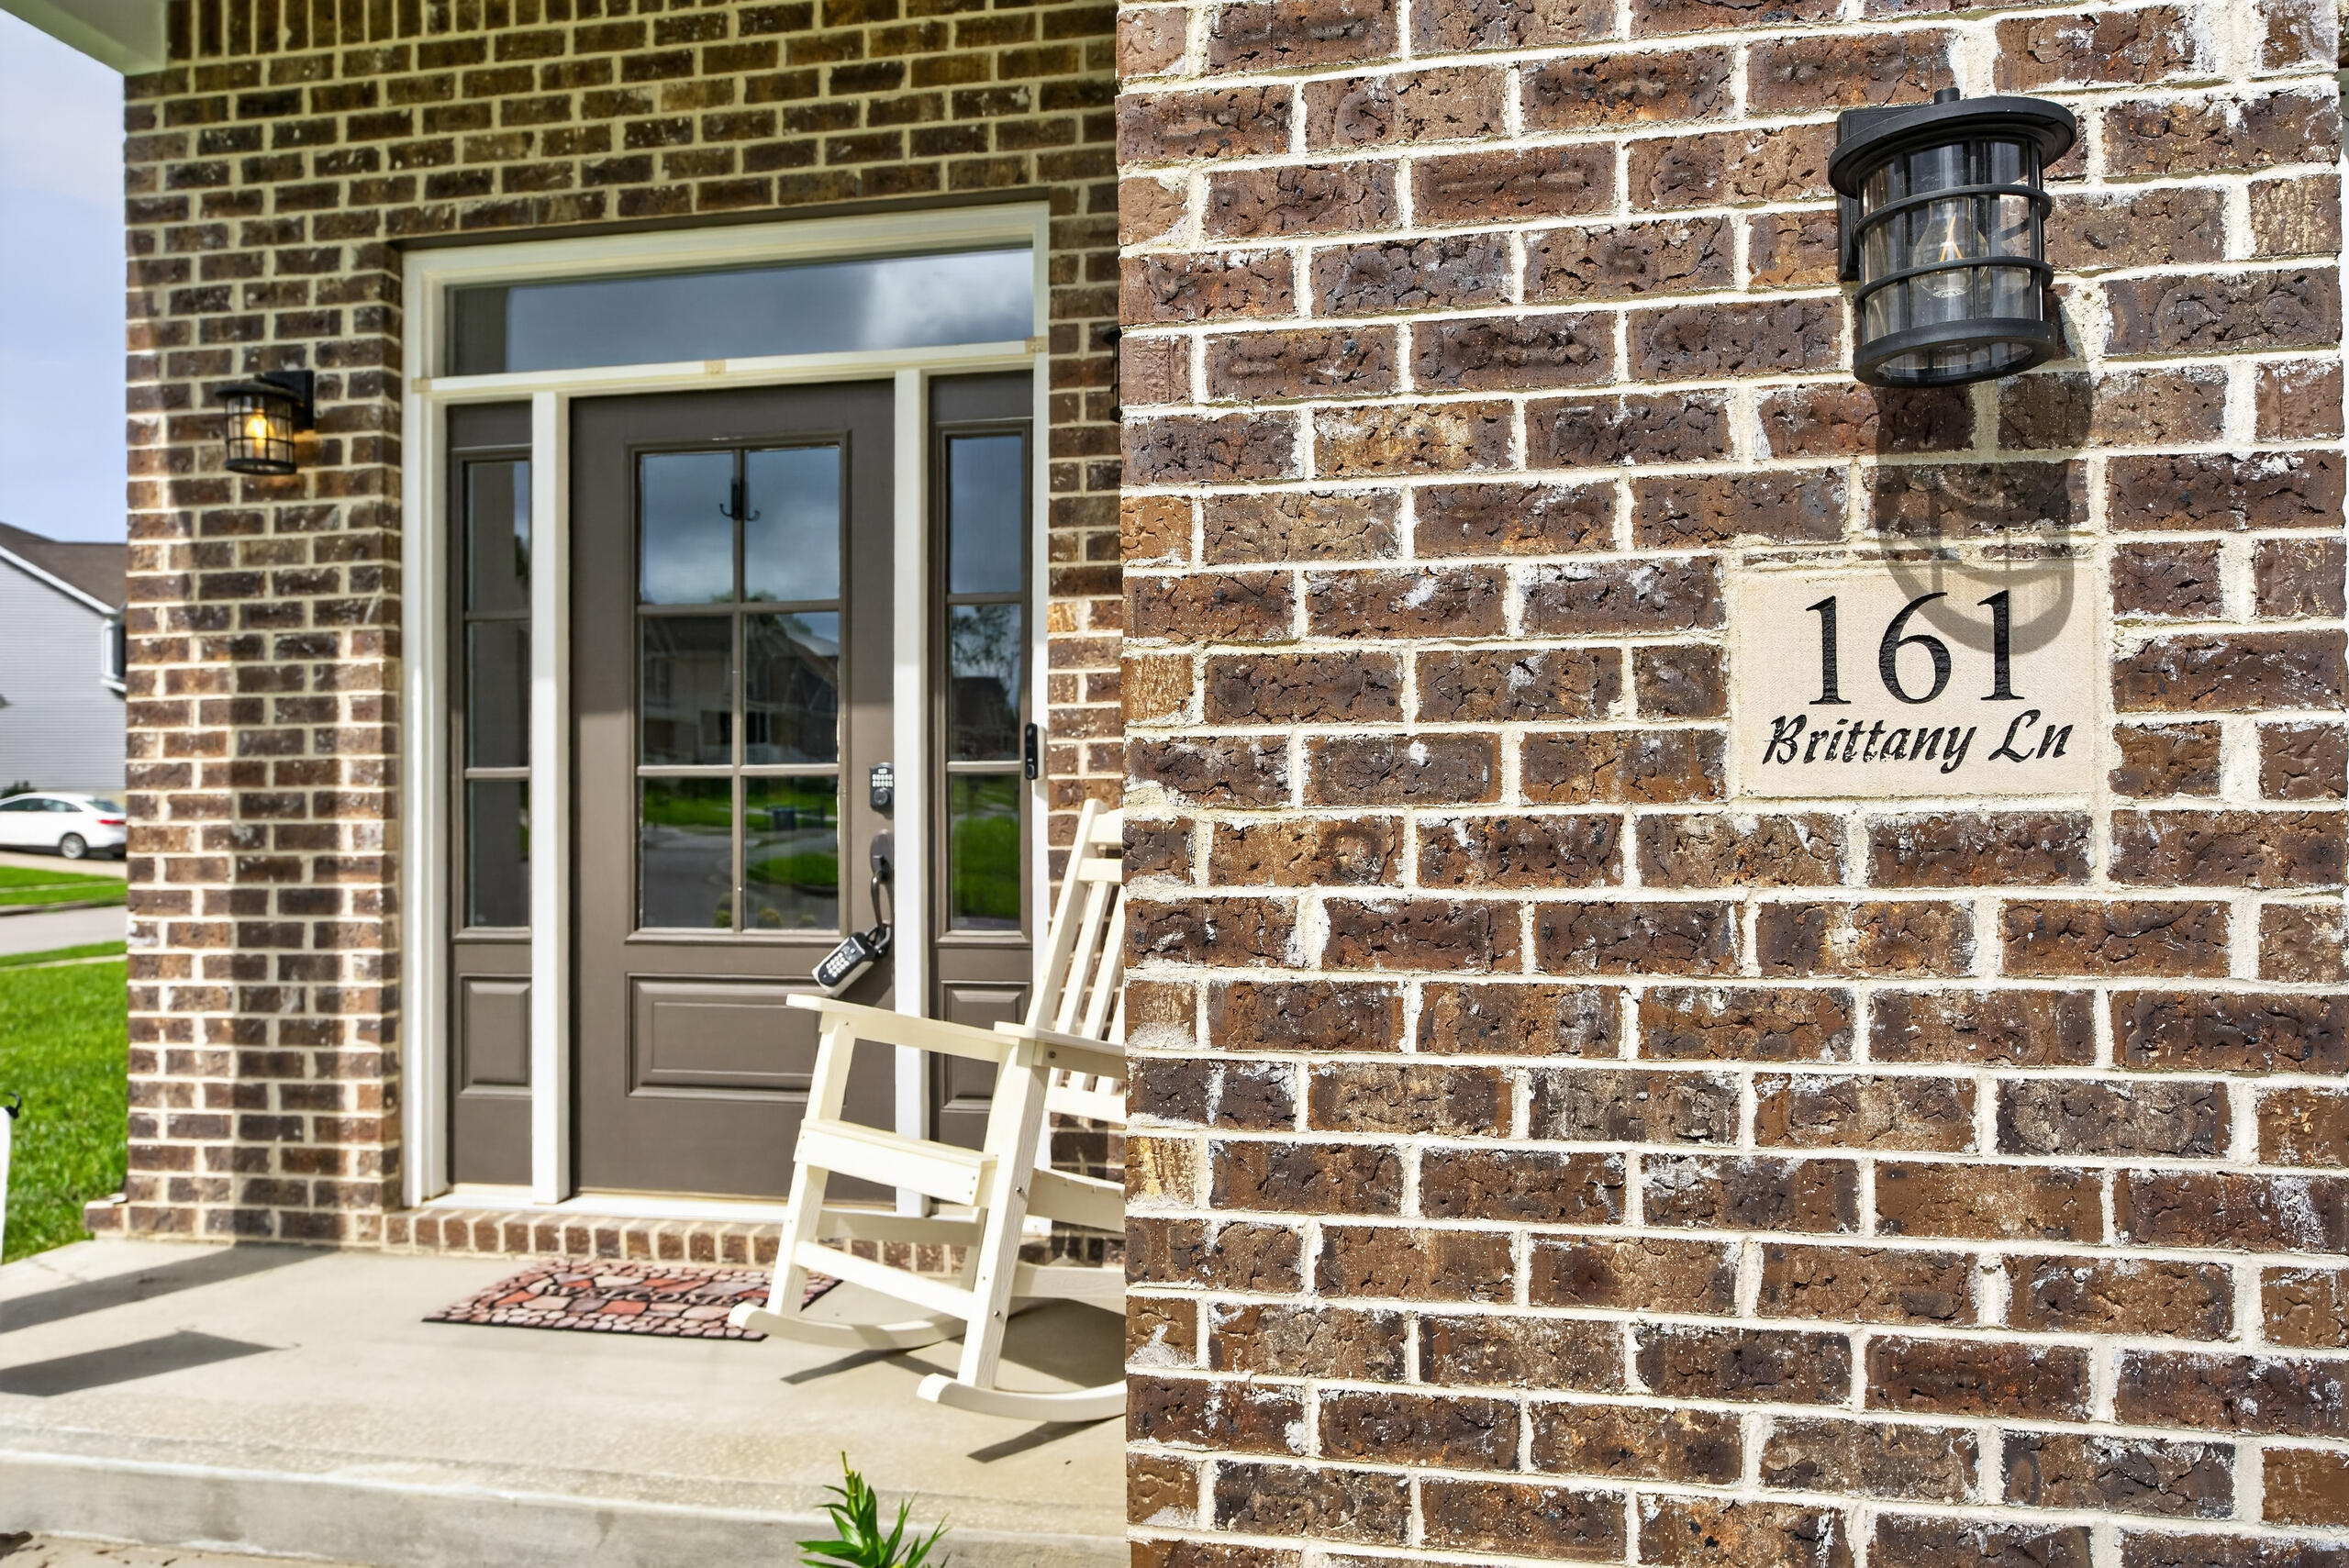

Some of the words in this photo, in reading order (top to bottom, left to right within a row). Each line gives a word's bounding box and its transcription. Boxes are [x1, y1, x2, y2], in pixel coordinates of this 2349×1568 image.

[1805, 589, 2025, 706] 161
[1762, 713, 1977, 775] Brittany
[1987, 708, 2074, 763] Ln
